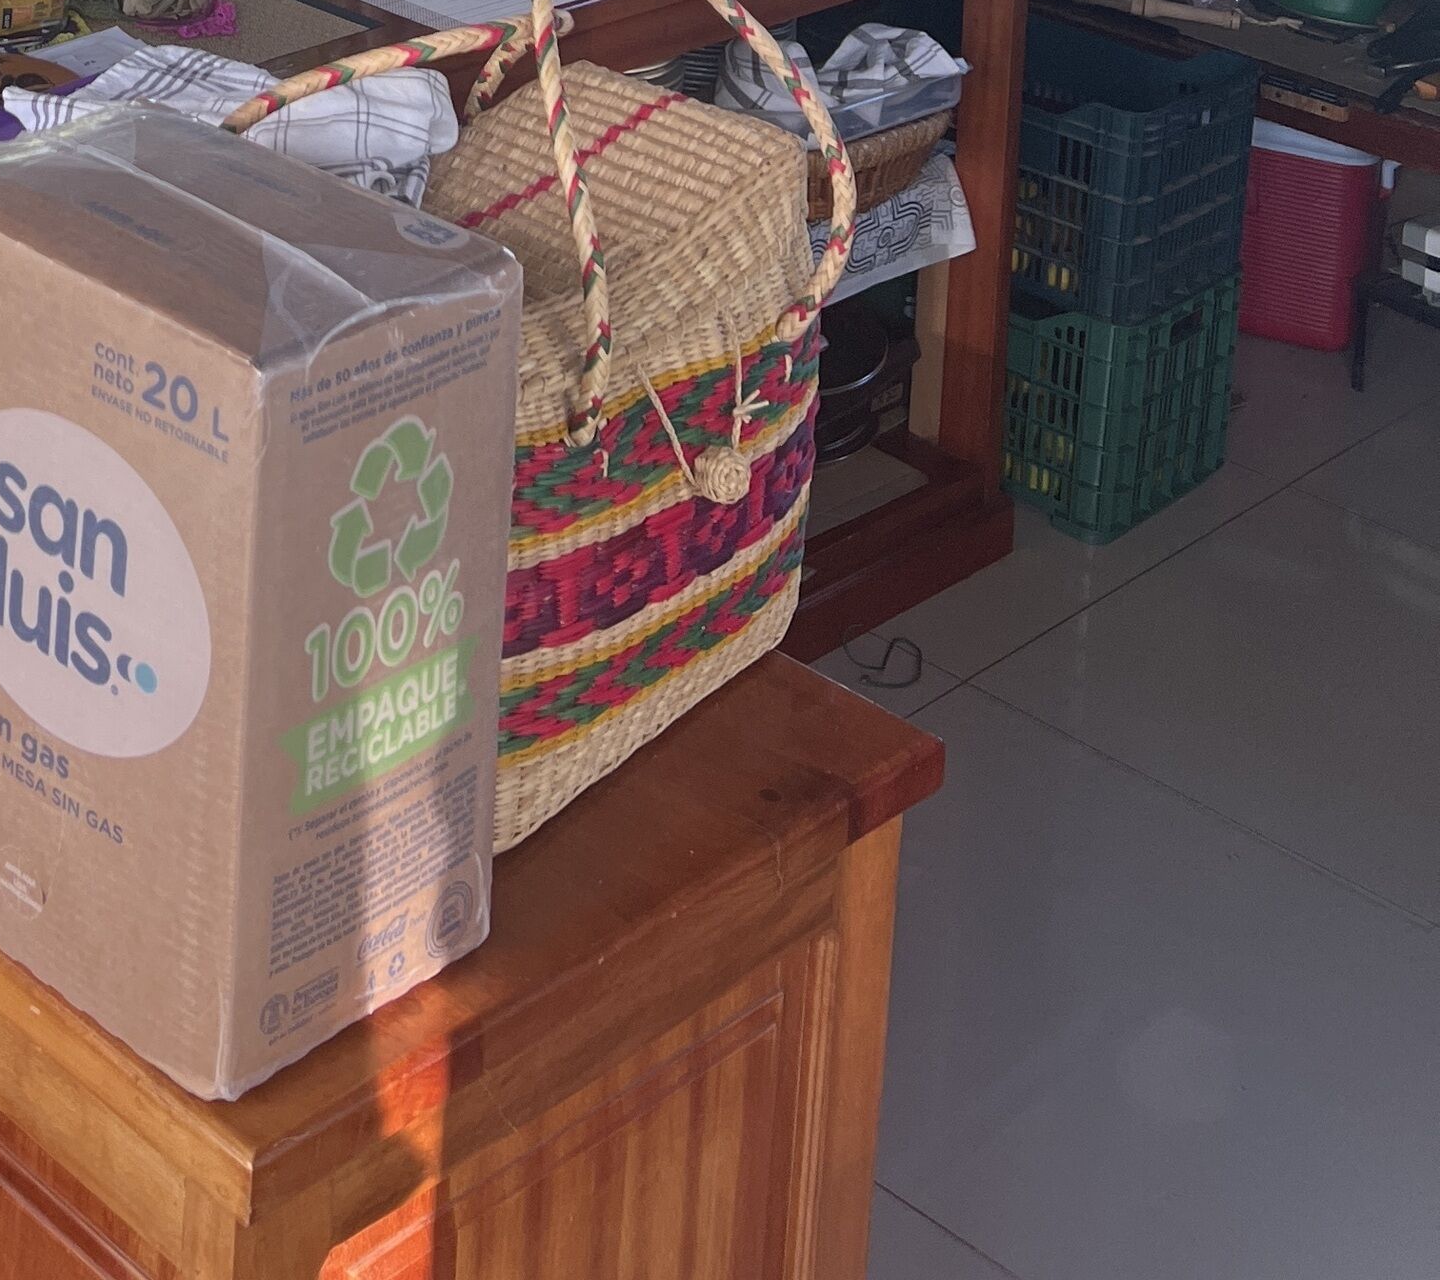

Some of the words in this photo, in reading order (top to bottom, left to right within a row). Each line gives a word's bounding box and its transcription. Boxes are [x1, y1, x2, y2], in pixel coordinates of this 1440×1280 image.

[93, 361, 135, 395] neto
[142, 360, 199, 423] 20
[212, 406, 230, 443] L
[91, 383, 134, 417] ENVASE
[135, 407, 153, 425] NO
[154, 416, 230, 464] RETORNABLE
[304, 558, 465, 704] 100%
[305, 693, 458, 796] RECICLABLE
[307, 651, 459, 763] EMPAQUE
[2, 752, 47, 798] MESA
[51, 786, 81, 819] SIN
[86, 808, 124, 845] GAS
[21, 732, 70, 780] gas
